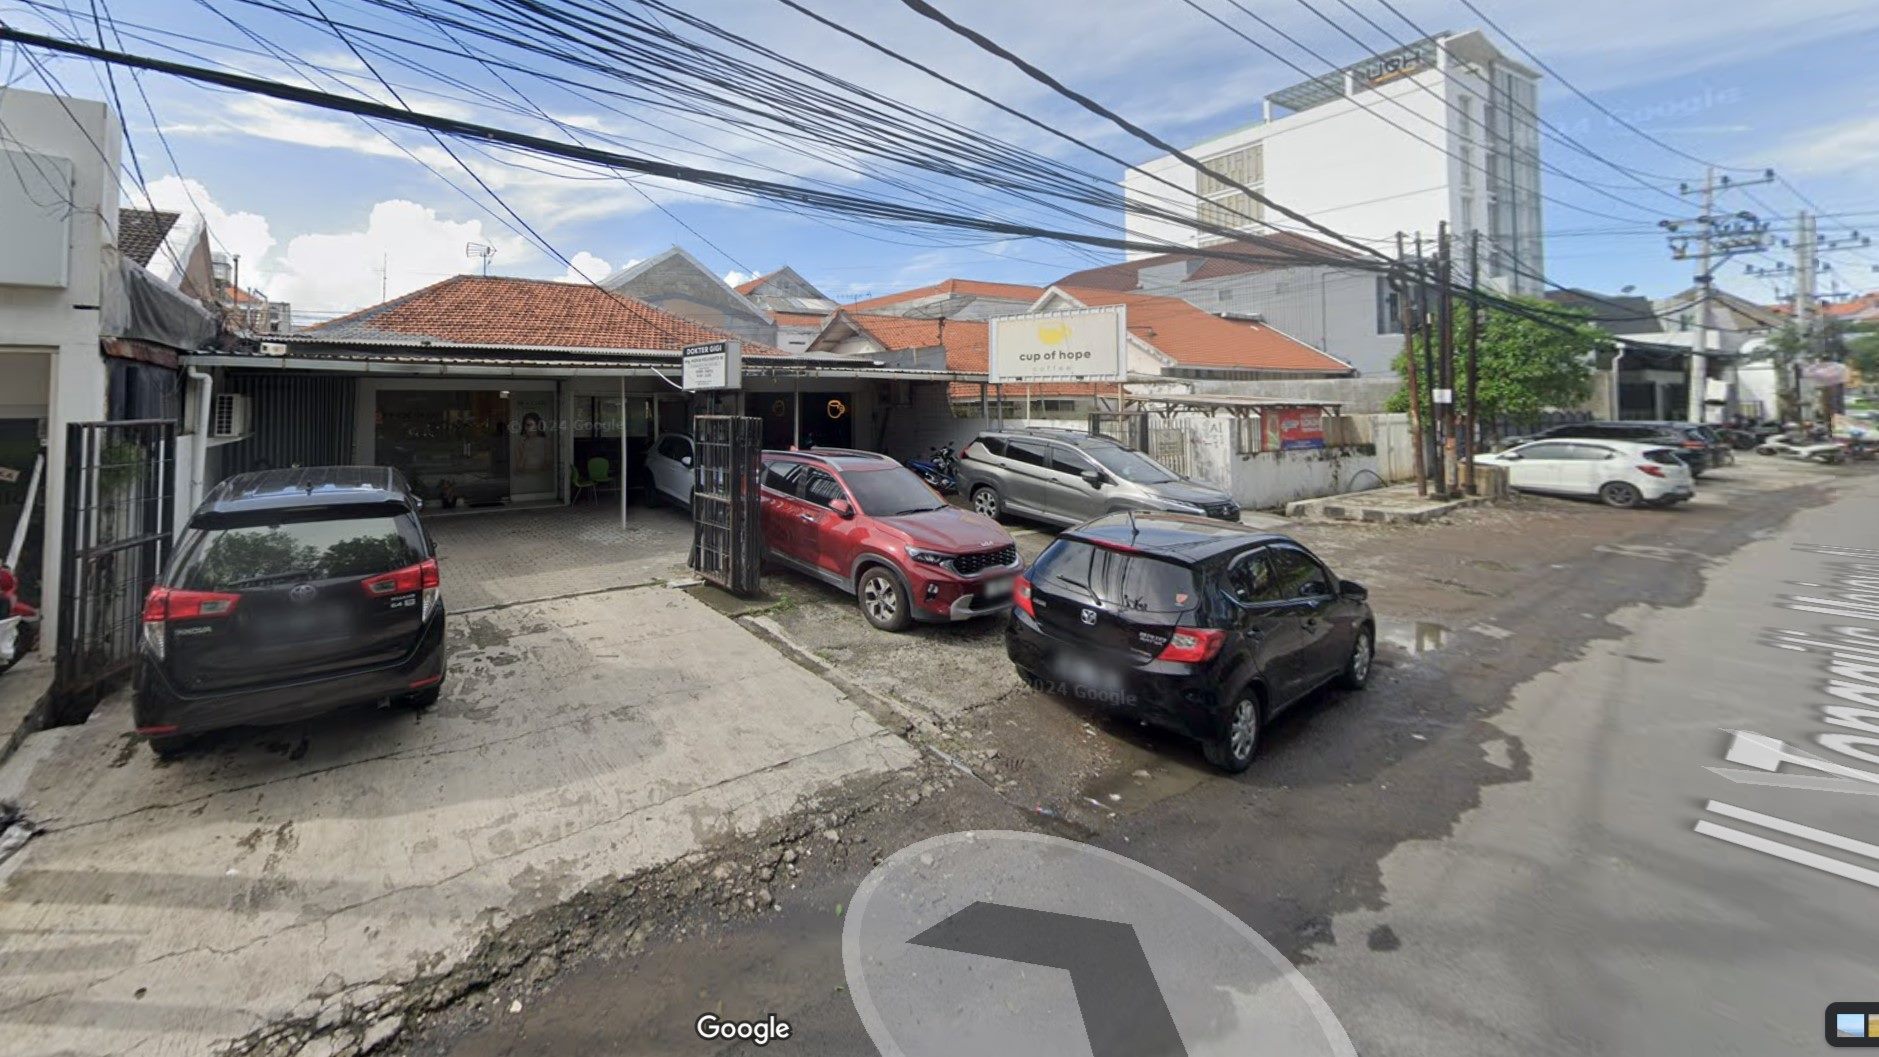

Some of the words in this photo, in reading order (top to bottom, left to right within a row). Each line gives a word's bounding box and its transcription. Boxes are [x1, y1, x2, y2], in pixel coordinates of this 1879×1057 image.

[687, 346, 708, 355] DOKTER
[709, 344, 722, 352] GIGI
[1019, 353, 1041, 362] cup
[1043, 350, 1056, 360] of
[1059, 350, 1092, 361] hope
